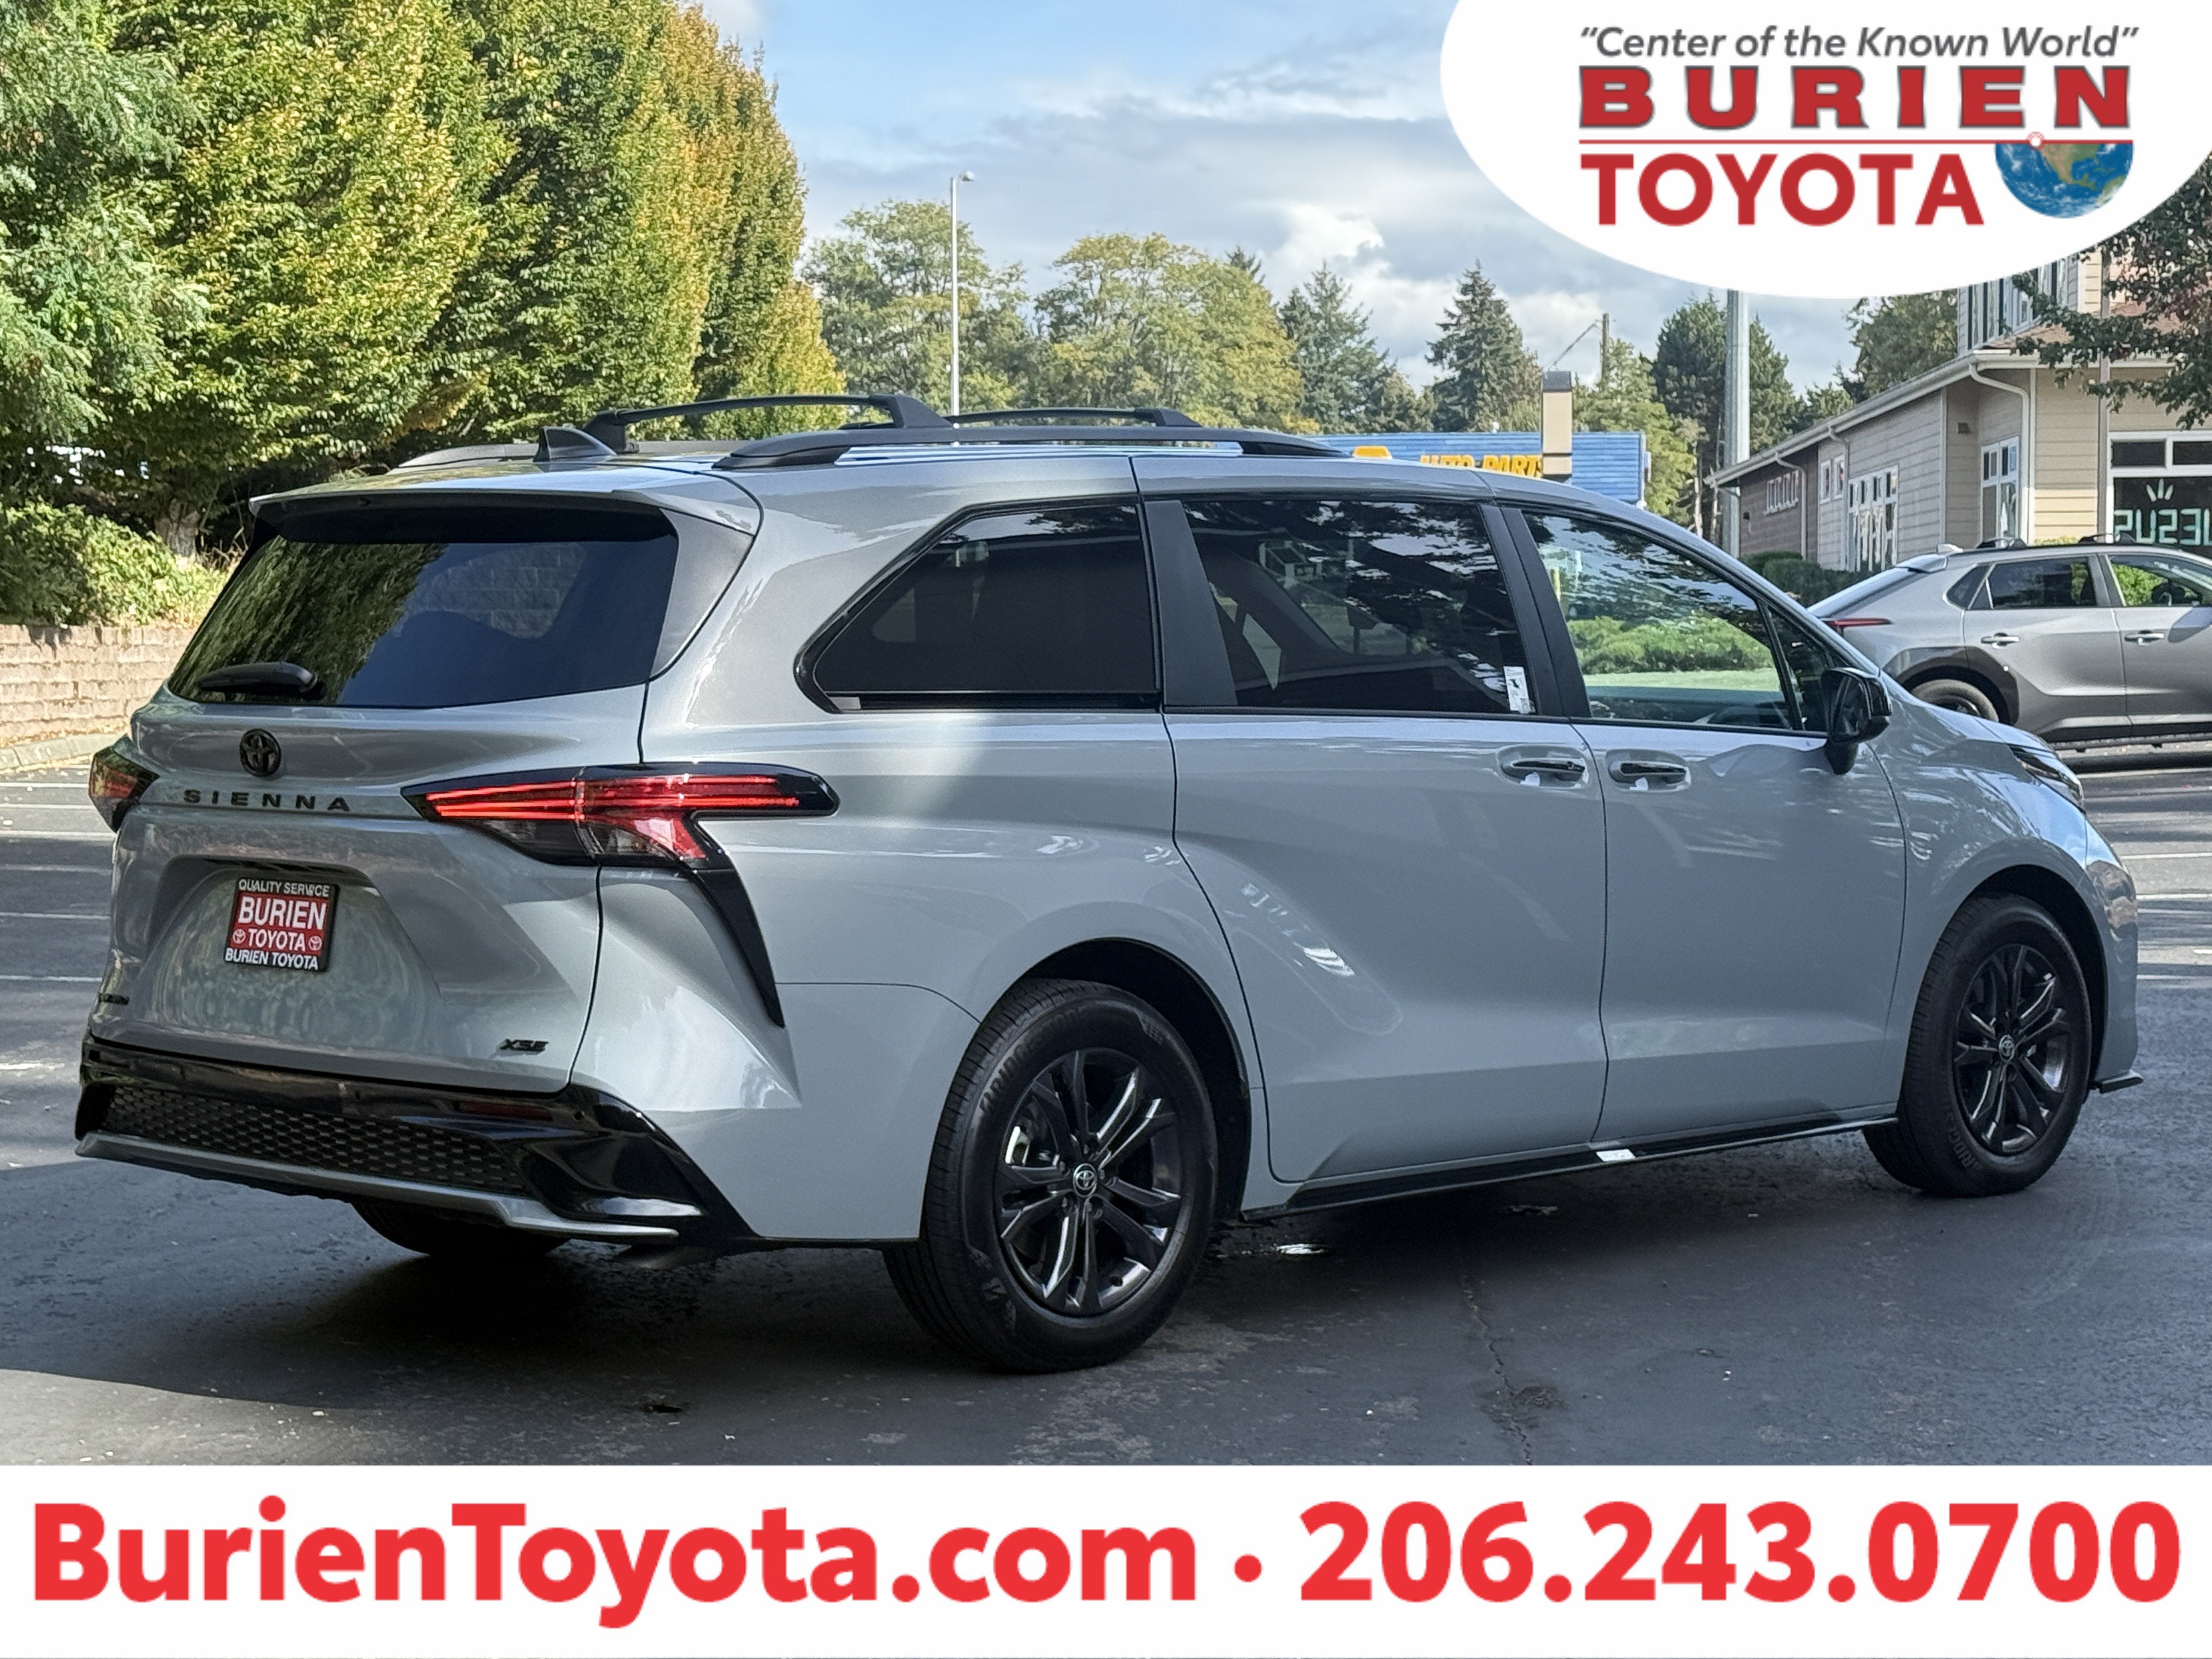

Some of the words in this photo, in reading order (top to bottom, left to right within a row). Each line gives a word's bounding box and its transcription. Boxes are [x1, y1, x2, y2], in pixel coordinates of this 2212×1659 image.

[183, 789, 350, 811] SIENNA
[238, 879, 282, 893] QUALITY
[283, 882, 330, 897] SERVICE
[238, 896, 327, 930] BURIEN
[248, 928, 306, 952] TOYOTA
[225, 947, 269, 965] BURIEN
[272, 952, 319, 970] TOYOTA
[499, 1038, 549, 1052] XSE
